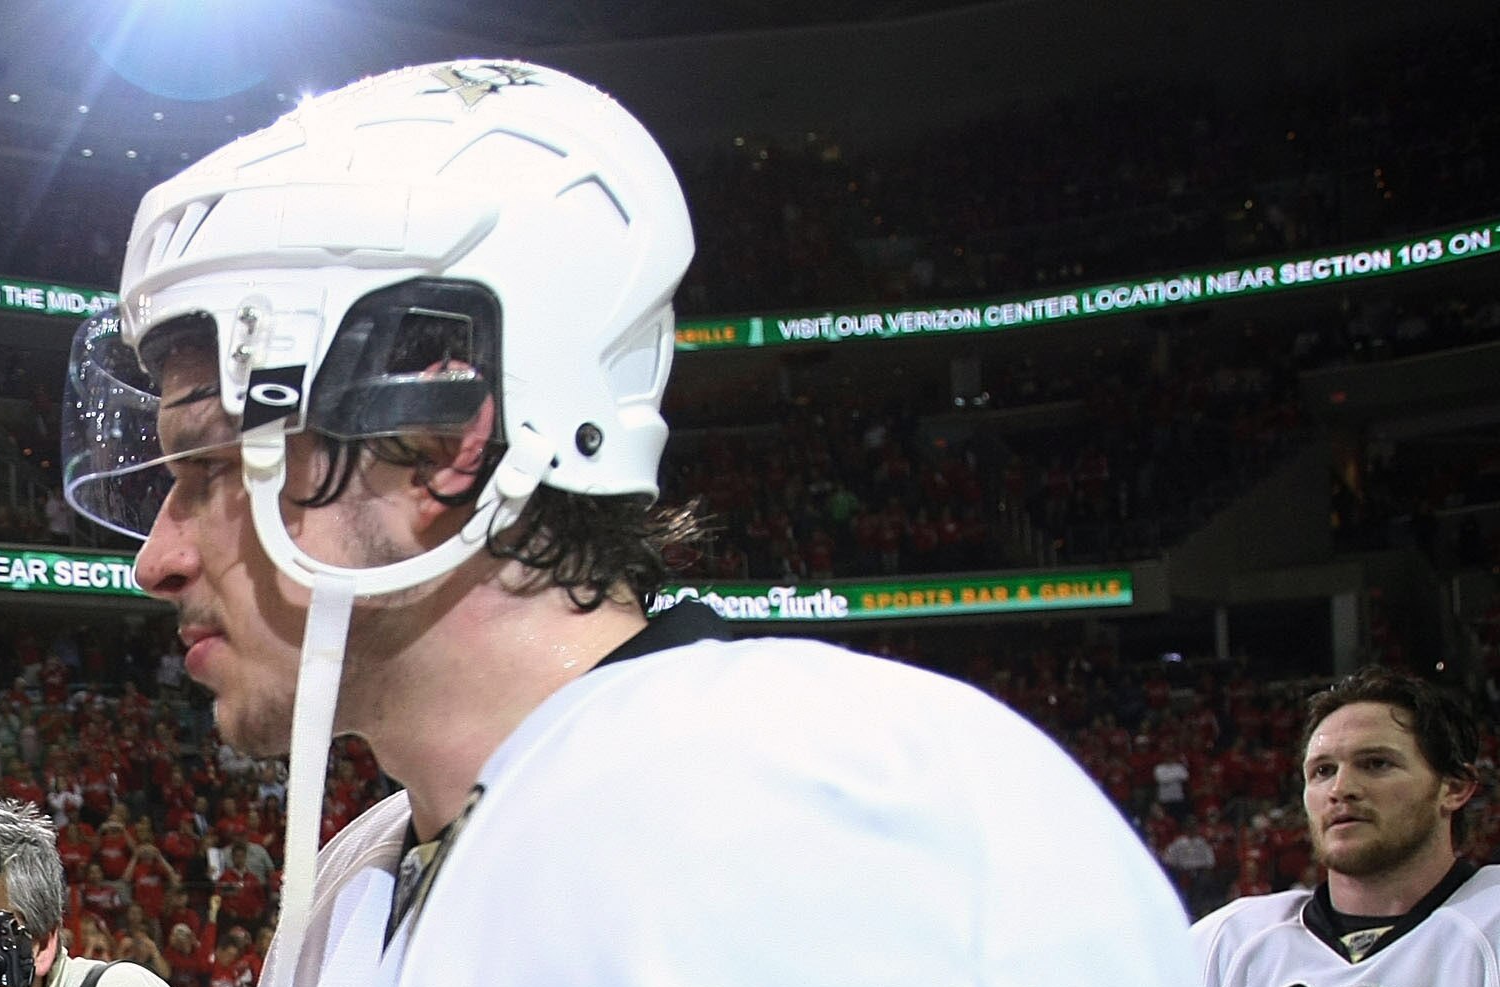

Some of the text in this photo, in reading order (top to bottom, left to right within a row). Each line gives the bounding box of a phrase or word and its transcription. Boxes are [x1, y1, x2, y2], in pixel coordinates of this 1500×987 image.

[2, 285, 45, 310] THE
[778, 228, 1491, 341] VISIT OUR VERIZON CENTER LOCATION NEAR SECTION 103 ON
[768, 586, 849, 618] Turtle
[862, 588, 953, 610] SPORTS
[960, 585, 1008, 605] BAR
[1040, 579, 1121, 601] GRILLE
